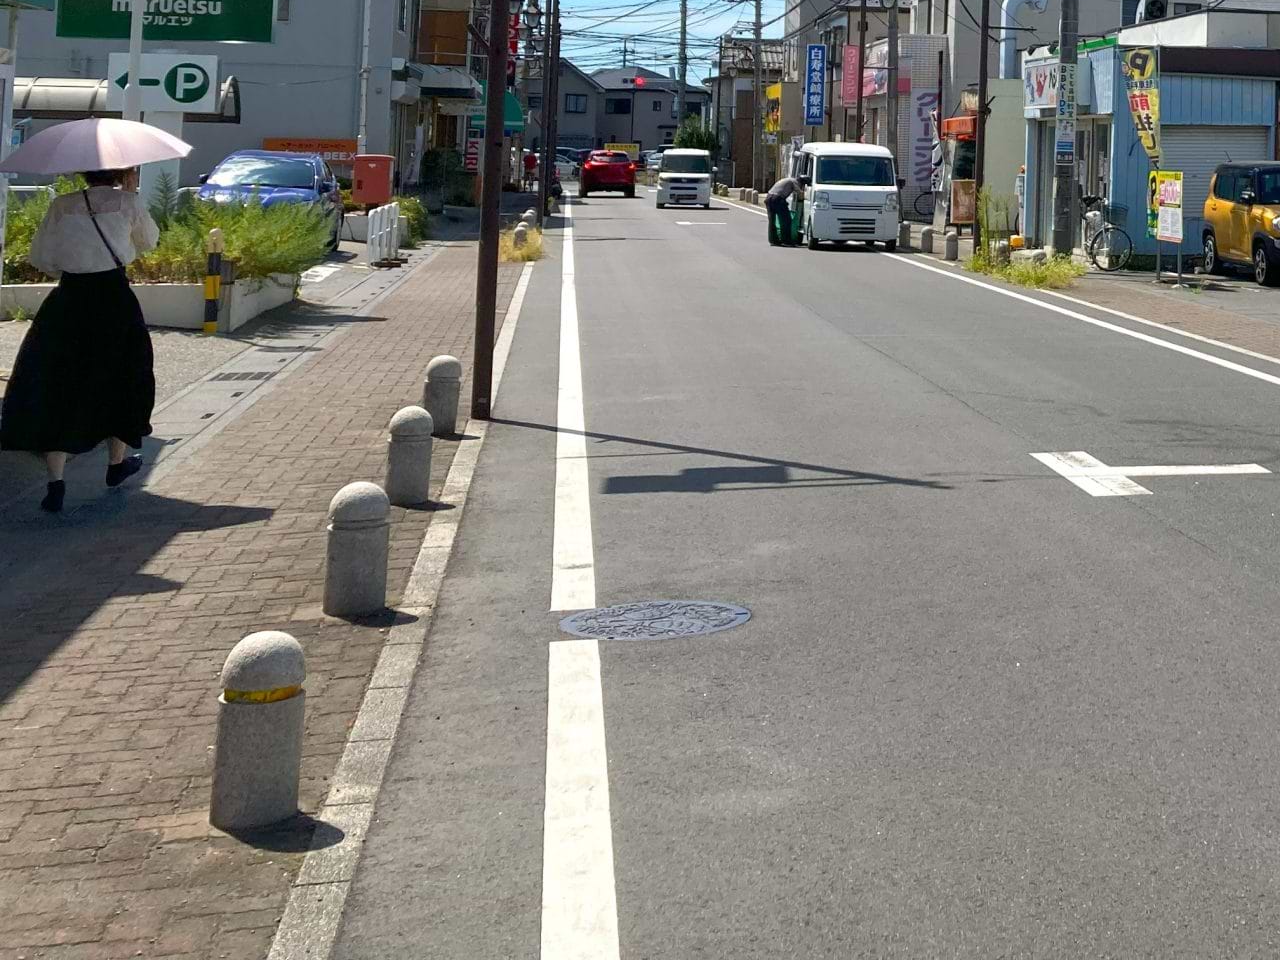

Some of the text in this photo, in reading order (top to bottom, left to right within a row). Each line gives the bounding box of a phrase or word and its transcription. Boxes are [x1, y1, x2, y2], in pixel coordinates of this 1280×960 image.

[141, 15, 193, 26] マルエツ
[176, 68, 200, 99] P
